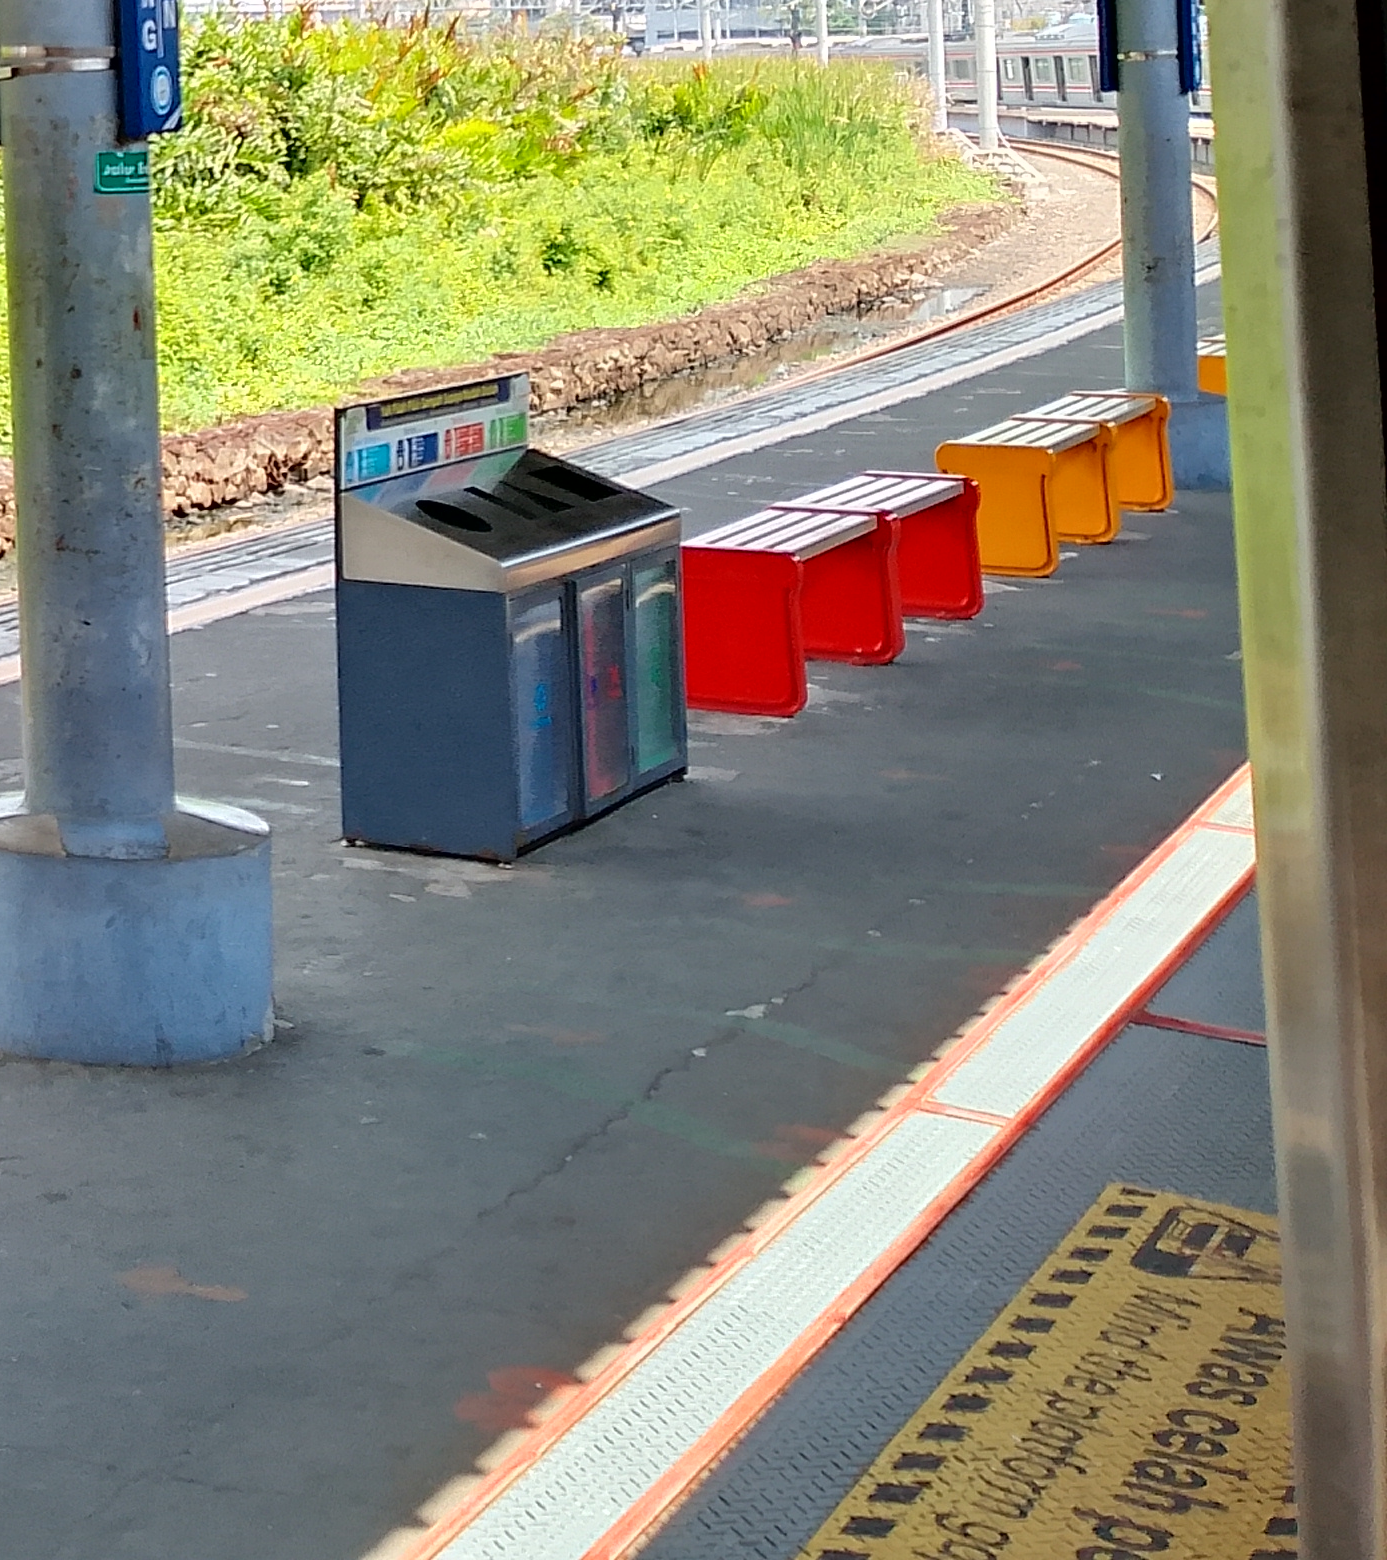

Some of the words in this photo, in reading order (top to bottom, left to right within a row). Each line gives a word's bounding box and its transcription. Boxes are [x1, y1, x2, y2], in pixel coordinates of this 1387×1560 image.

[1063, 1351, 1153, 1396] the
[1098, 1285, 1201, 1361] Mind
[1184, 1306, 1286, 1407] Awas
[969, 1390, 1114, 1520] platform
[1113, 1408, 1250, 1514] celah
